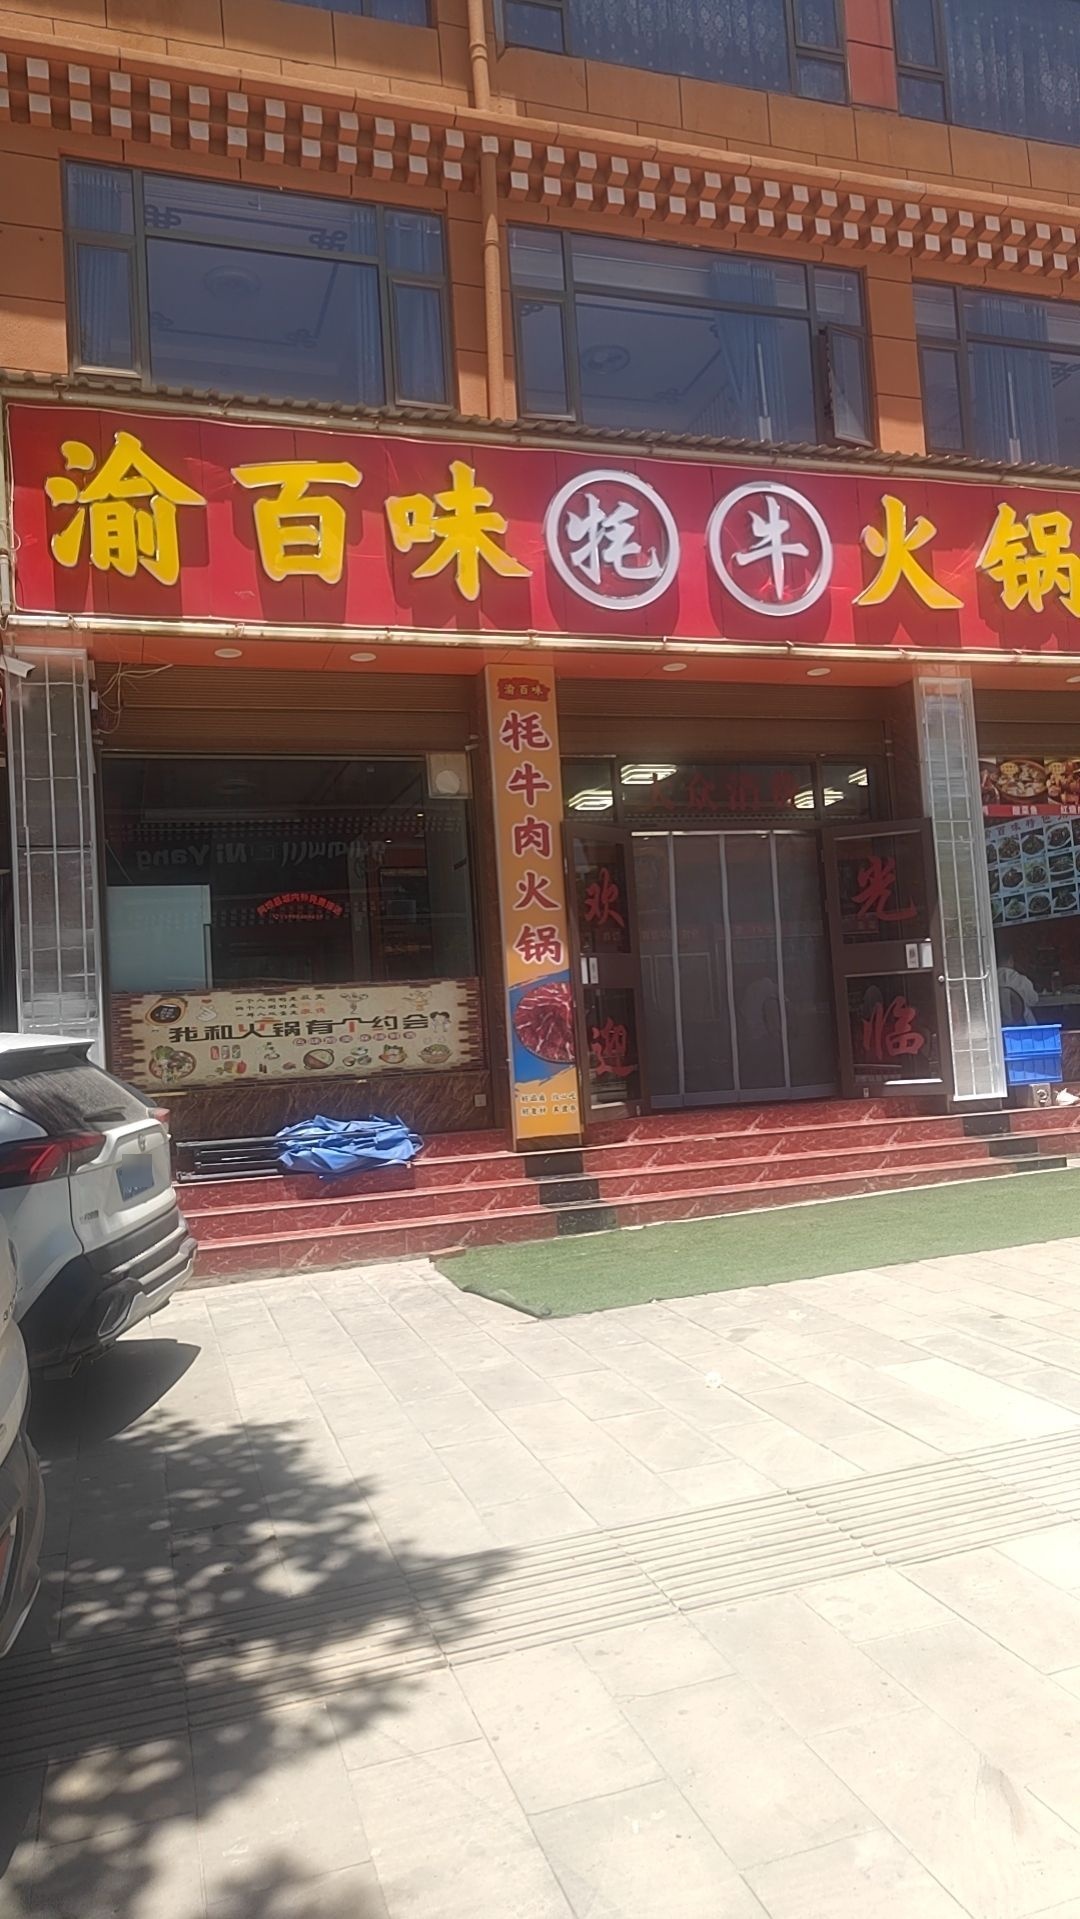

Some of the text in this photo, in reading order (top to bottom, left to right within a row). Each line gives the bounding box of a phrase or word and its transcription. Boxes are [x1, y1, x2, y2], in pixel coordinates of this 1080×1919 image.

[45, 431, 1080, 618] 渝百味牦牛火锅
[503, 683, 544, 696] 渝百味
[501, 711, 563, 965] 牦牛肉火锅
[1060, 804, 1080, 815] 红烧
[169, 1012, 430, 1043] 我和火锅有个约会
[585, 867, 638, 1077] 欢迎
[852, 854, 925, 1060] 光临
